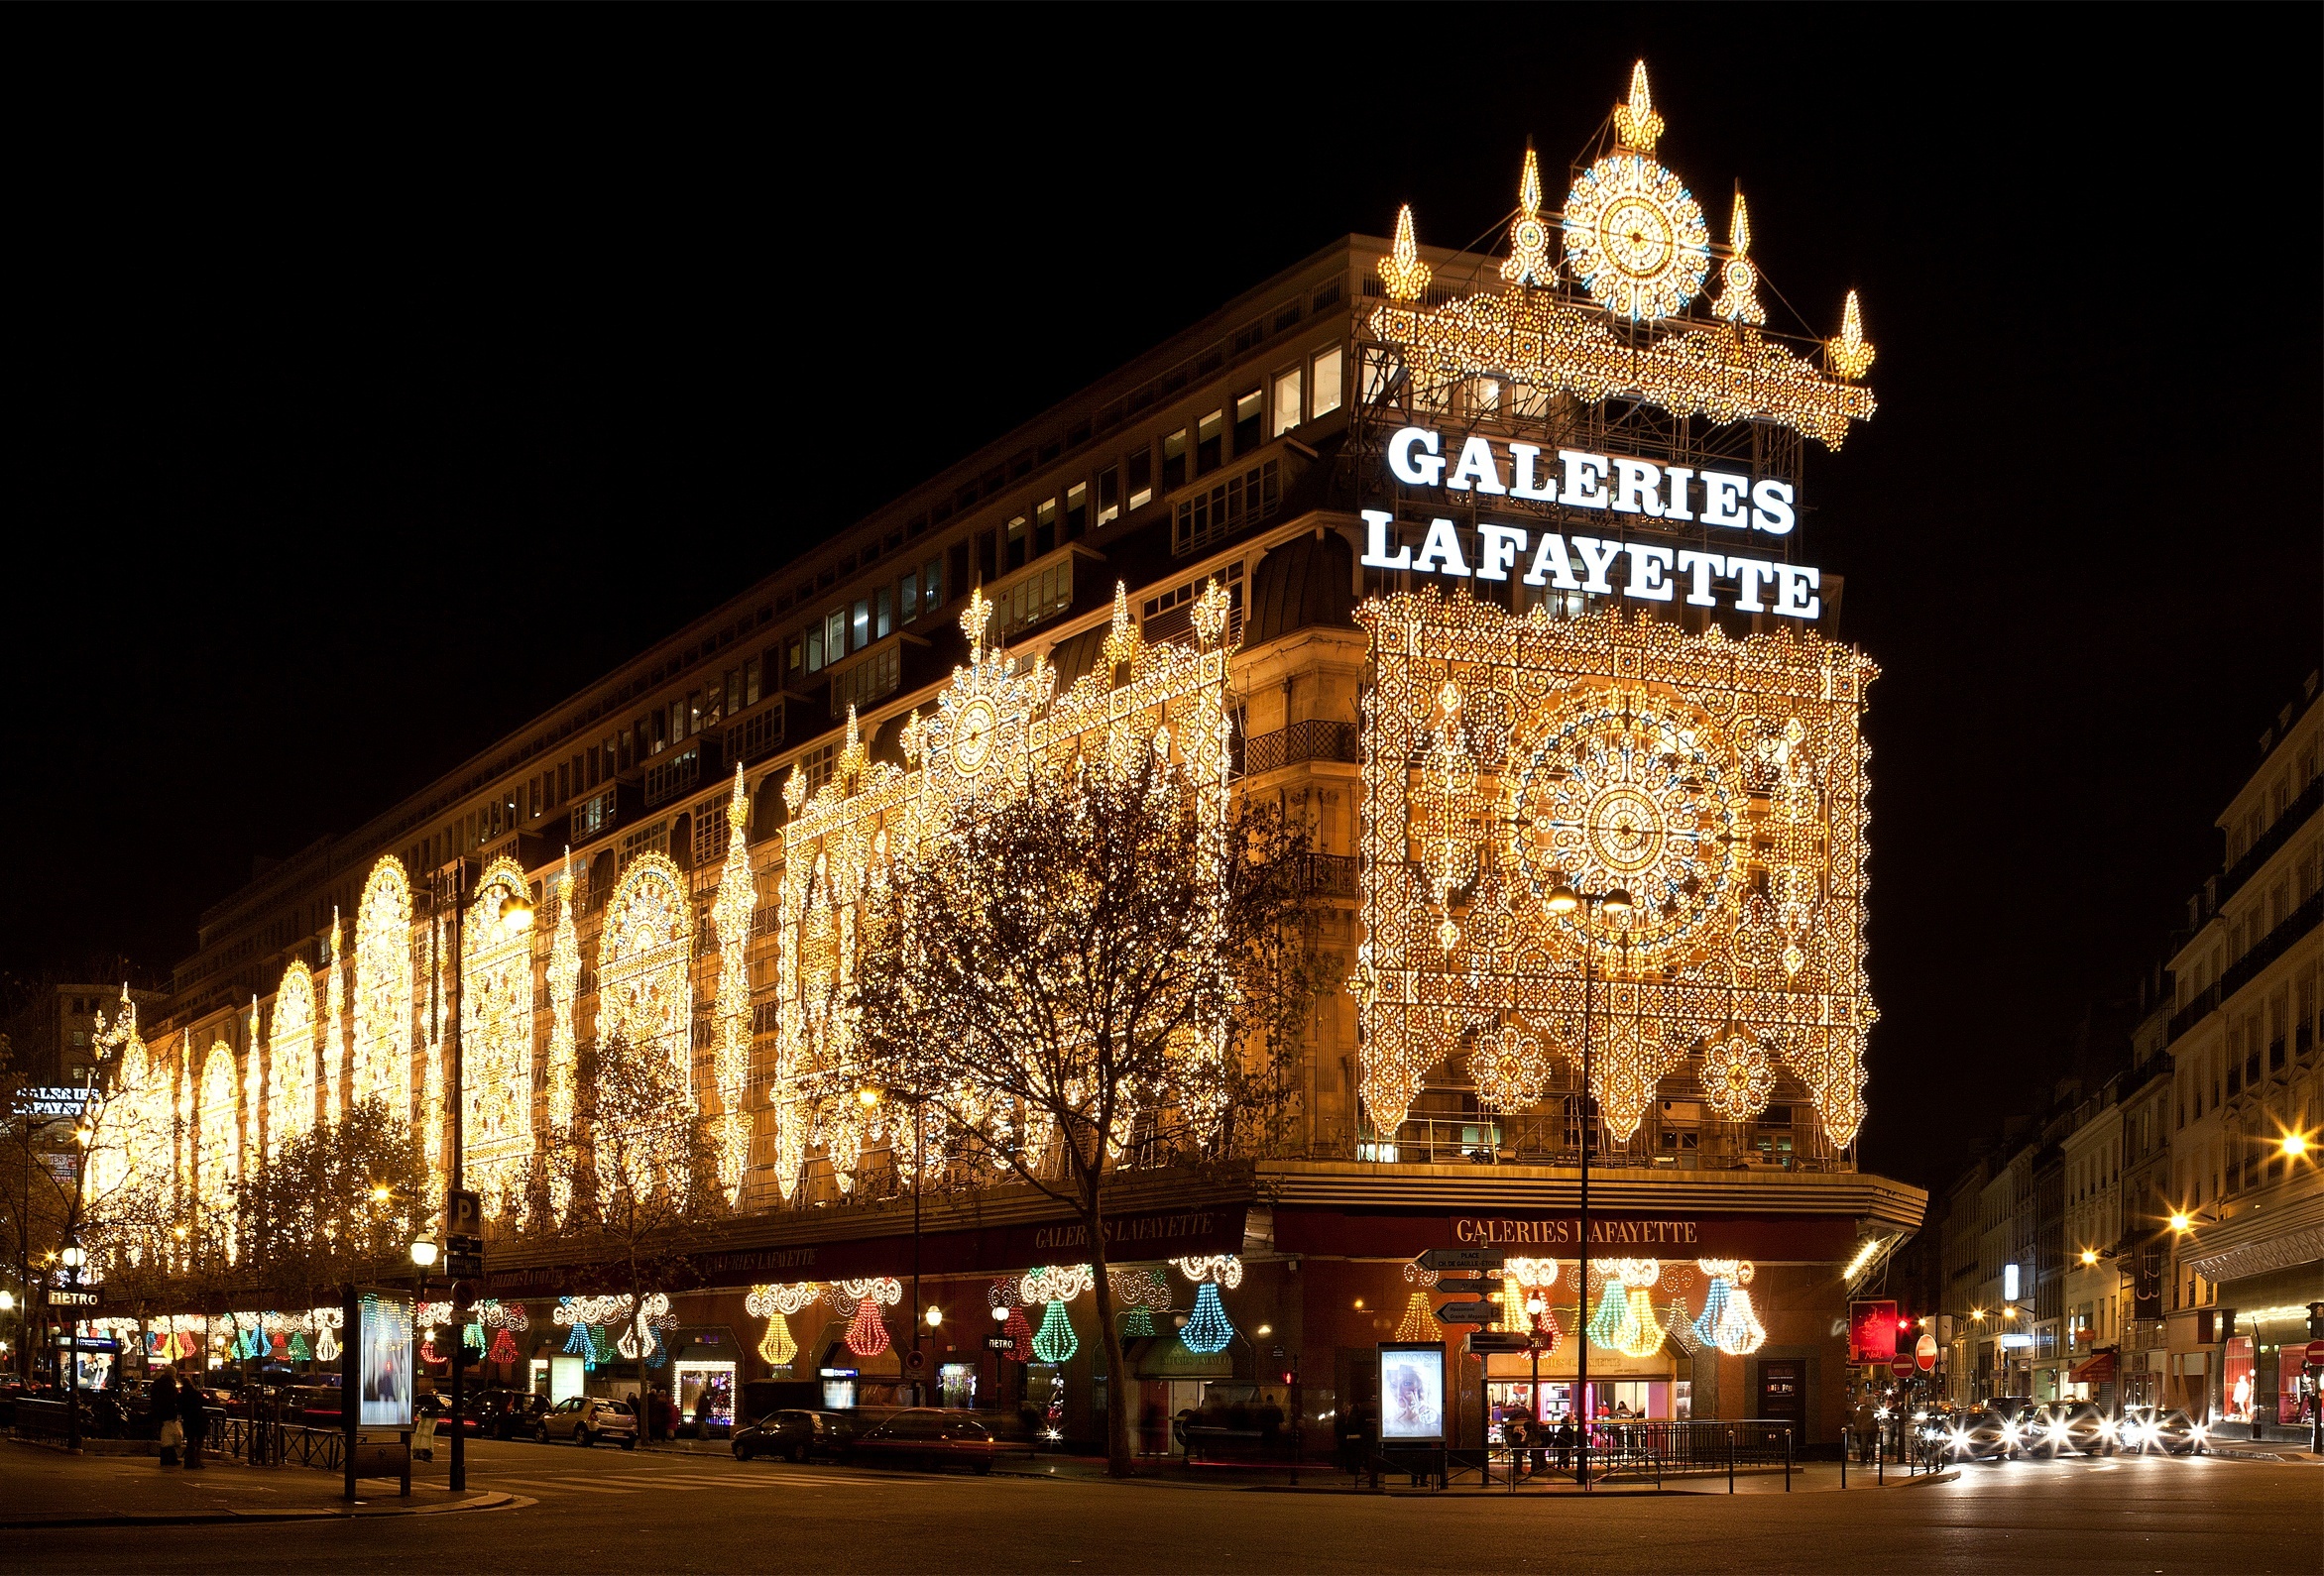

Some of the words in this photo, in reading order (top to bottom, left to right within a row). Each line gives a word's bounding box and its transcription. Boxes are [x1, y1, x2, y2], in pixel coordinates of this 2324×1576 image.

[1387, 426, 1796, 535] GALERIES
[1360, 509, 1820, 619] LAFAYETTE
[1036, 1222, 1112, 1249] GALERS
[1115, 1211, 1215, 1242] LAFAYETTE
[1456, 1219, 1569, 1243] GALERIES
[51, 1292, 98, 1305] METRO
[988, 1339, 1013, 1349] METRO
[1385, 1353, 1440, 1363] SWAROVSKI
